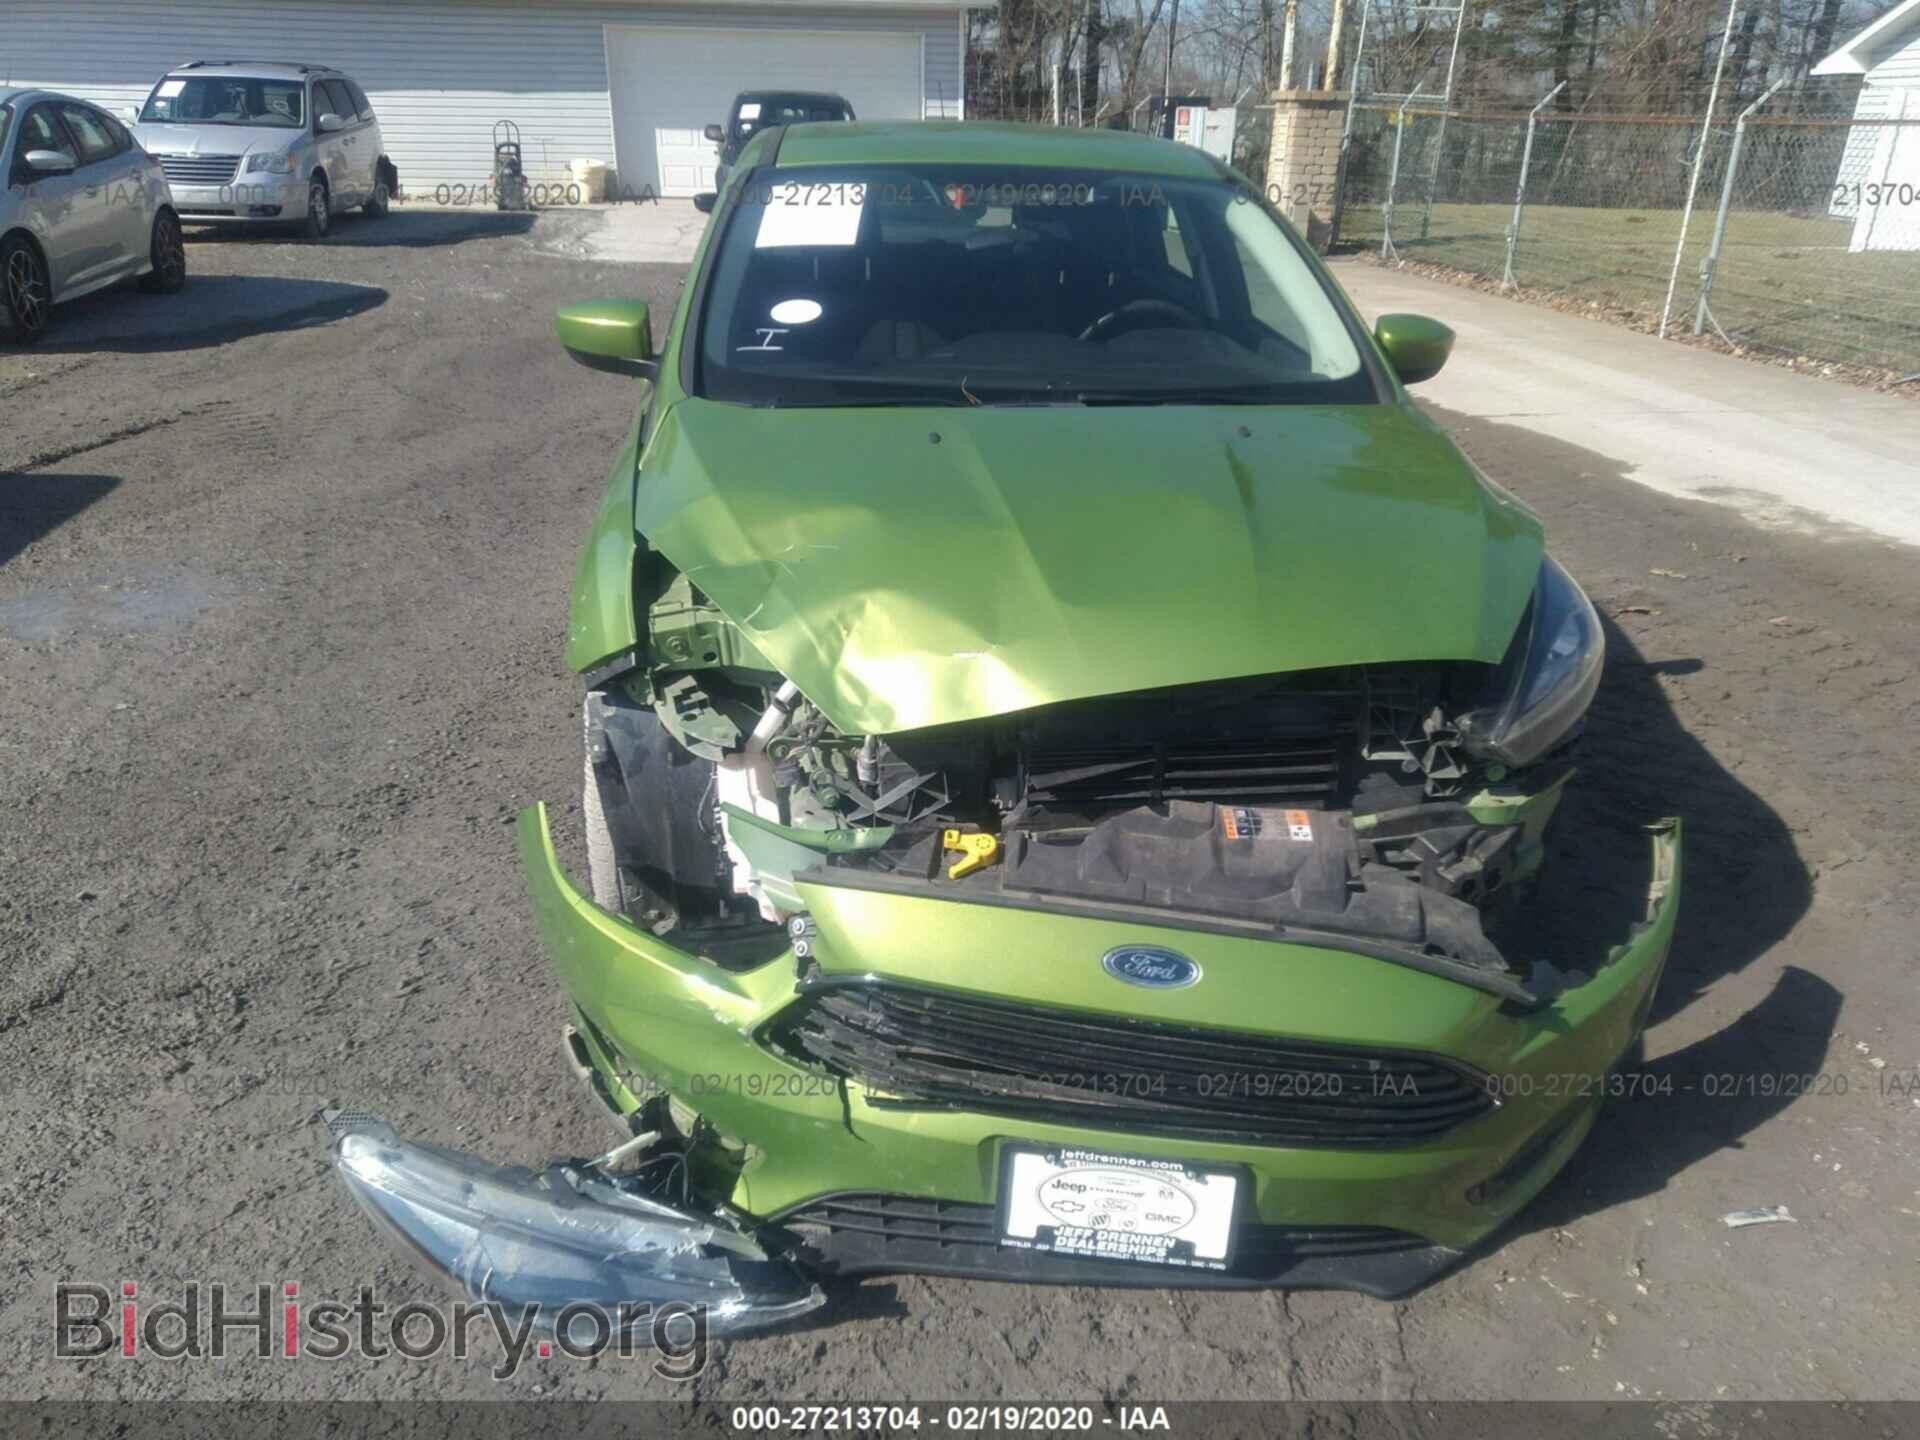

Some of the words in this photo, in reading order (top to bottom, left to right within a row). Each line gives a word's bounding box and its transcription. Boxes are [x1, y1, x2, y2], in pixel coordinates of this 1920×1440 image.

[1124, 954, 1176, 980] Ford
[1060, 1149, 1184, 1171] jeffdrennen.com
[1051, 1179, 1087, 1194] Jeep
[1145, 1211, 1182, 1225] GMC
[1053, 1225, 1095, 1240] JEFF
[1096, 1230, 1176, 1249] DRENNEN
